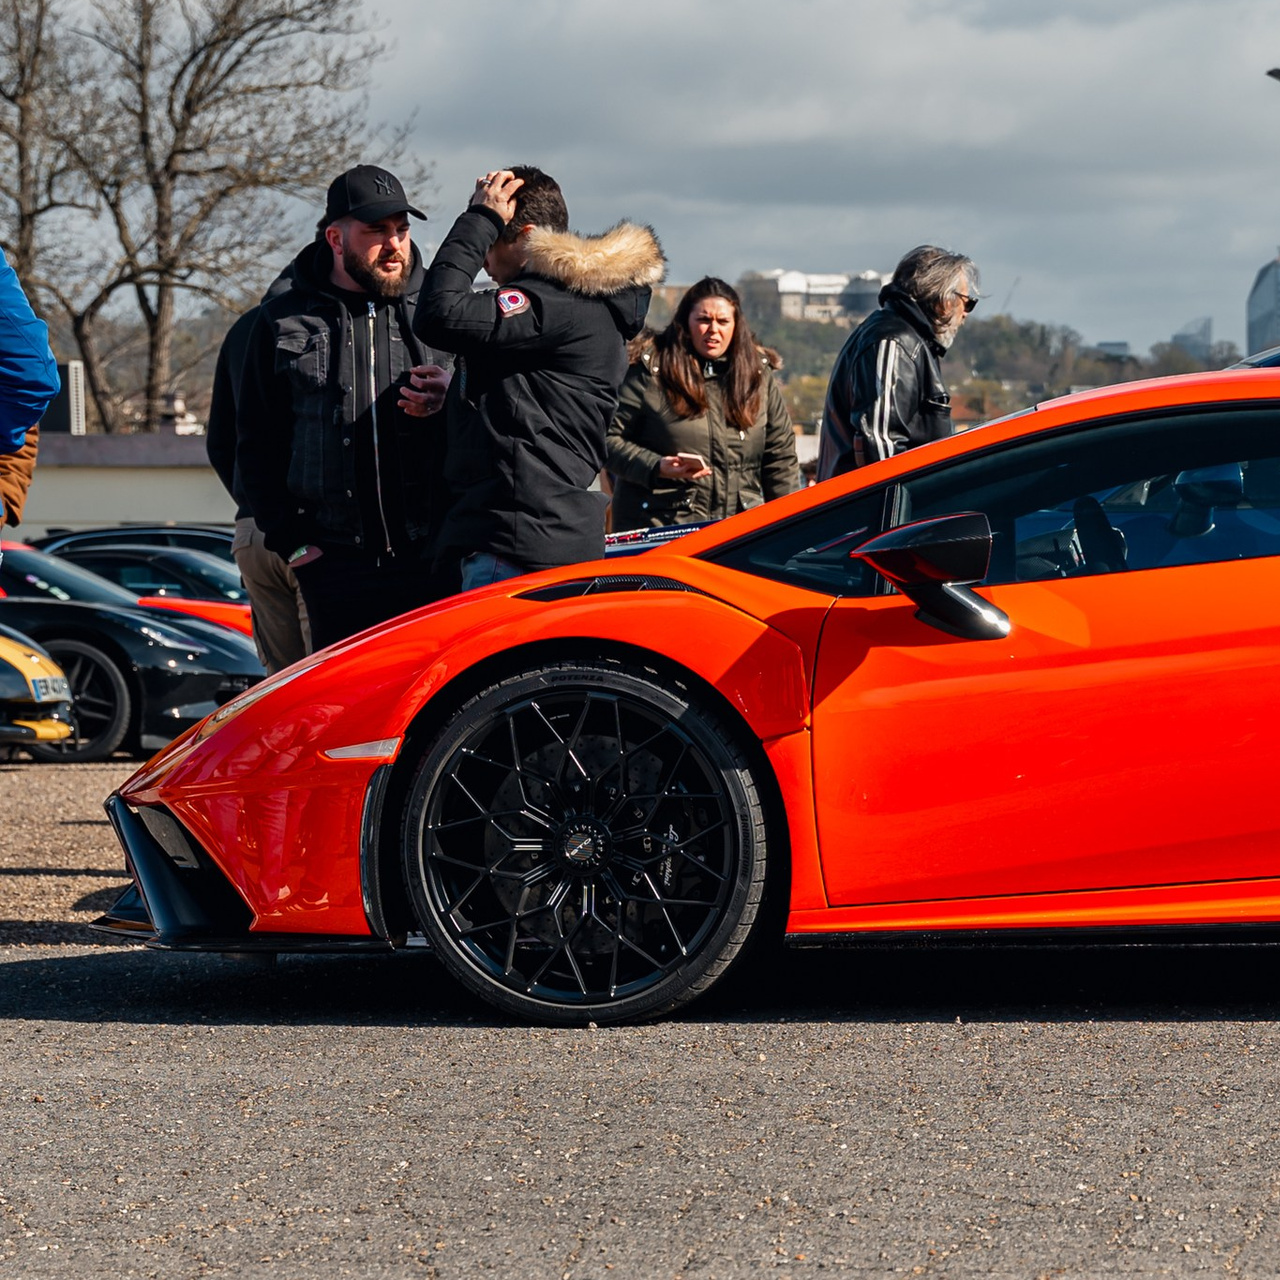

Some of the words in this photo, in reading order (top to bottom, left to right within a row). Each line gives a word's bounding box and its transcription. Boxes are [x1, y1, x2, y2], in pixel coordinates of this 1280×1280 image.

[551, 674, 604, 682] POTENZA
[570, 837, 592, 856] STO
[740, 814, 750, 878] BRIDGESTONE
